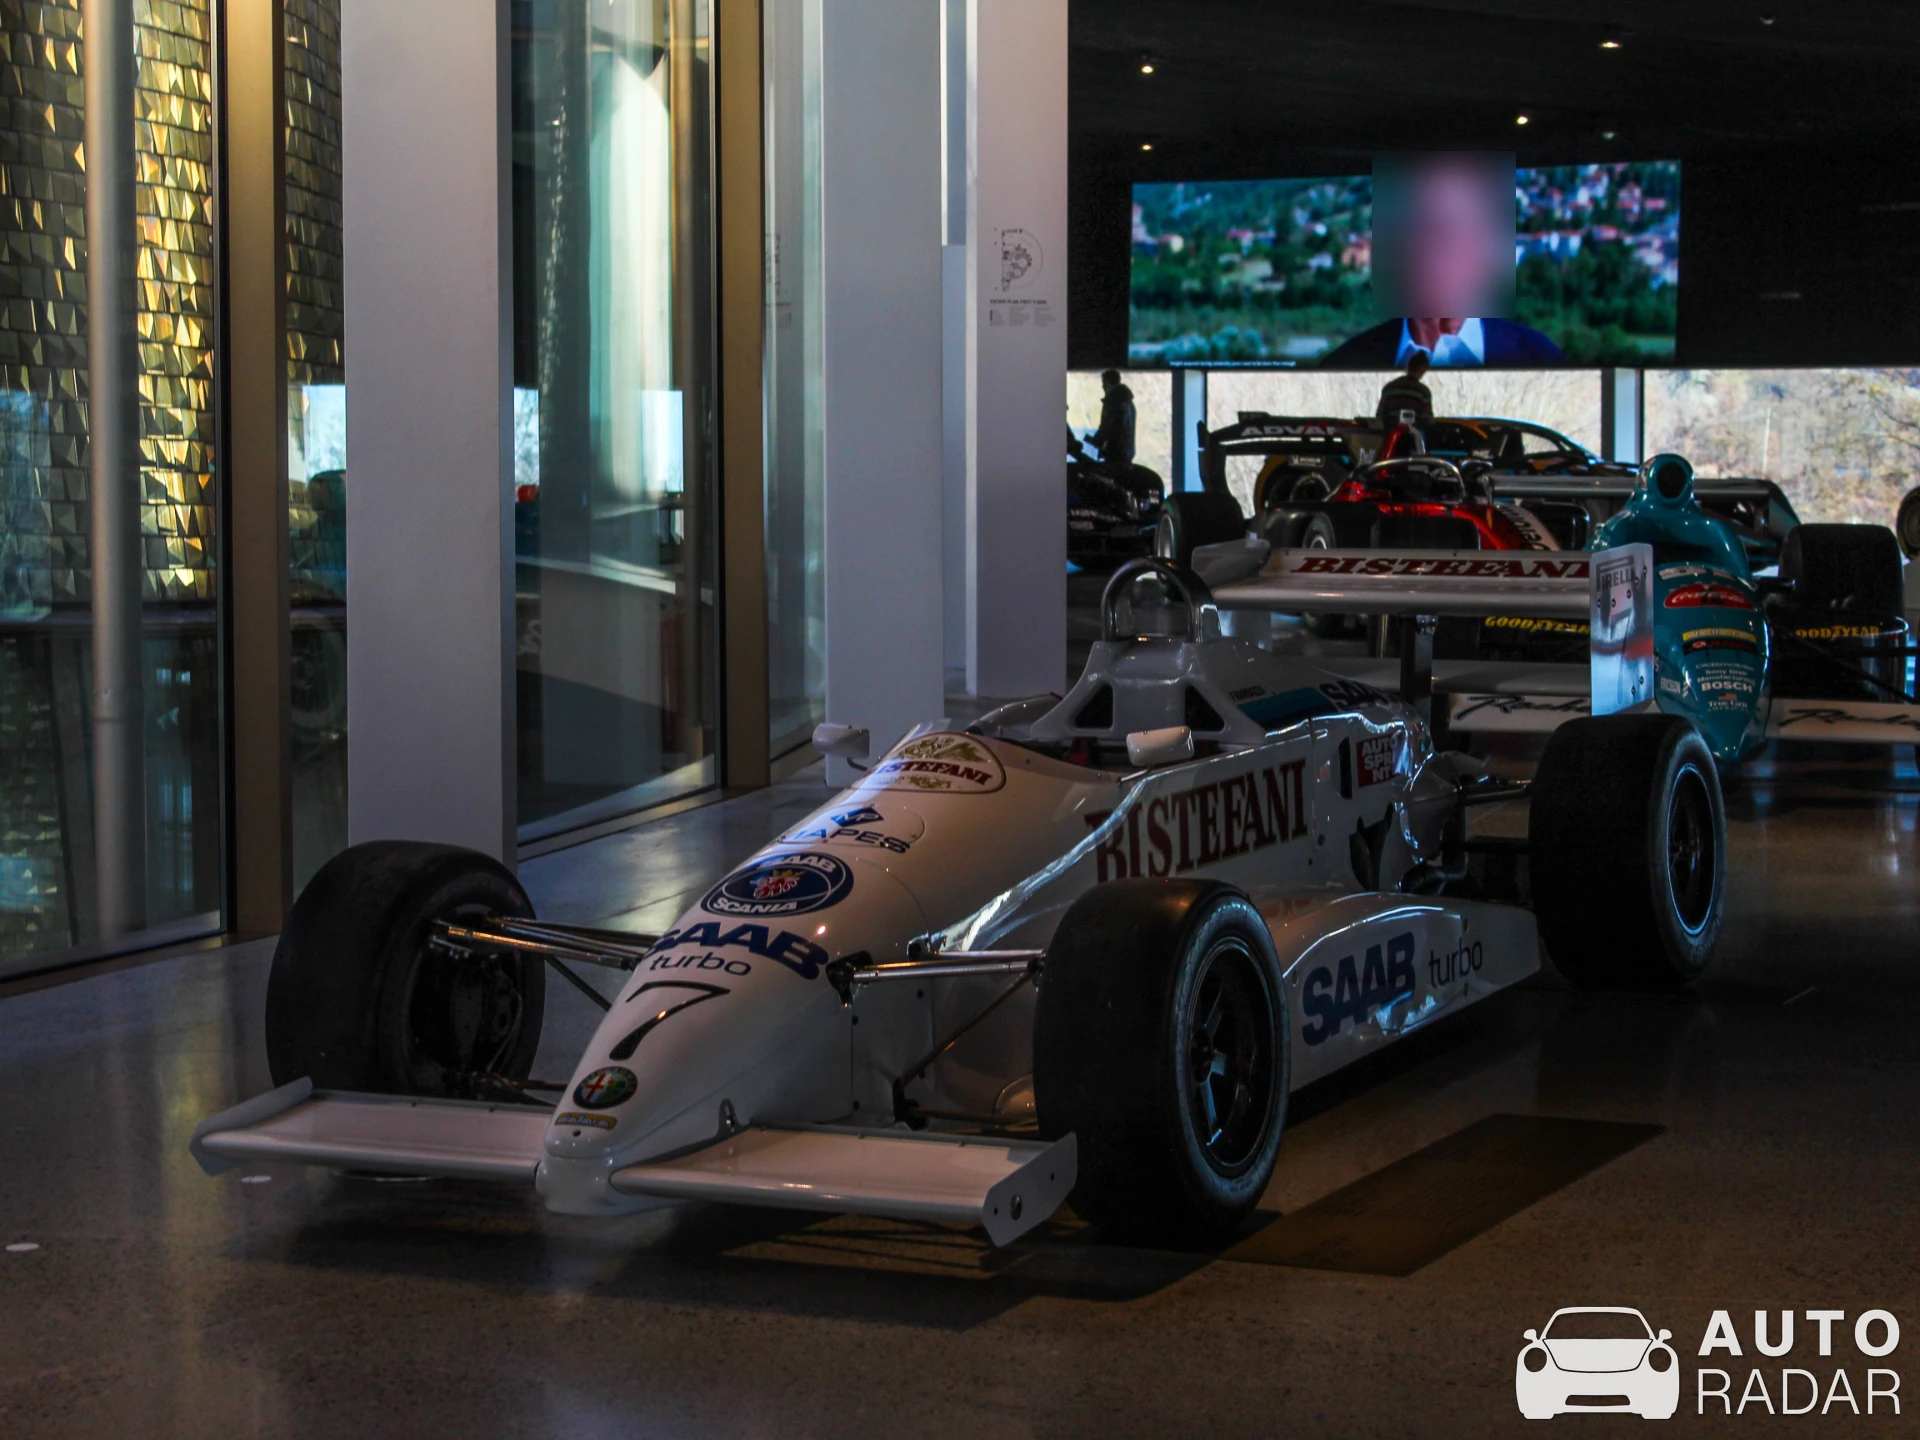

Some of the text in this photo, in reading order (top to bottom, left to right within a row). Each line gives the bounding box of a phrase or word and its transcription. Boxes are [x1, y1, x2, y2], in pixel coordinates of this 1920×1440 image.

[1291, 557, 1589, 578] BISTEFANI
[1794, 625, 1880, 641] OODYEAR
[1701, 681, 1753, 693] BOSCH
[1361, 736, 1398, 757] AUTO
[866, 759, 993, 786] ISTEFANI
[1083, 760, 1308, 883] BISTEFANI
[757, 854, 837, 873] SAAB
[713, 896, 799, 914] SCANIA
[645, 922, 829, 980] SAAB
[650, 951, 752, 976] turbo
[1302, 931, 1483, 1046] SAAB turbo
[609, 981, 731, 1061] 7
